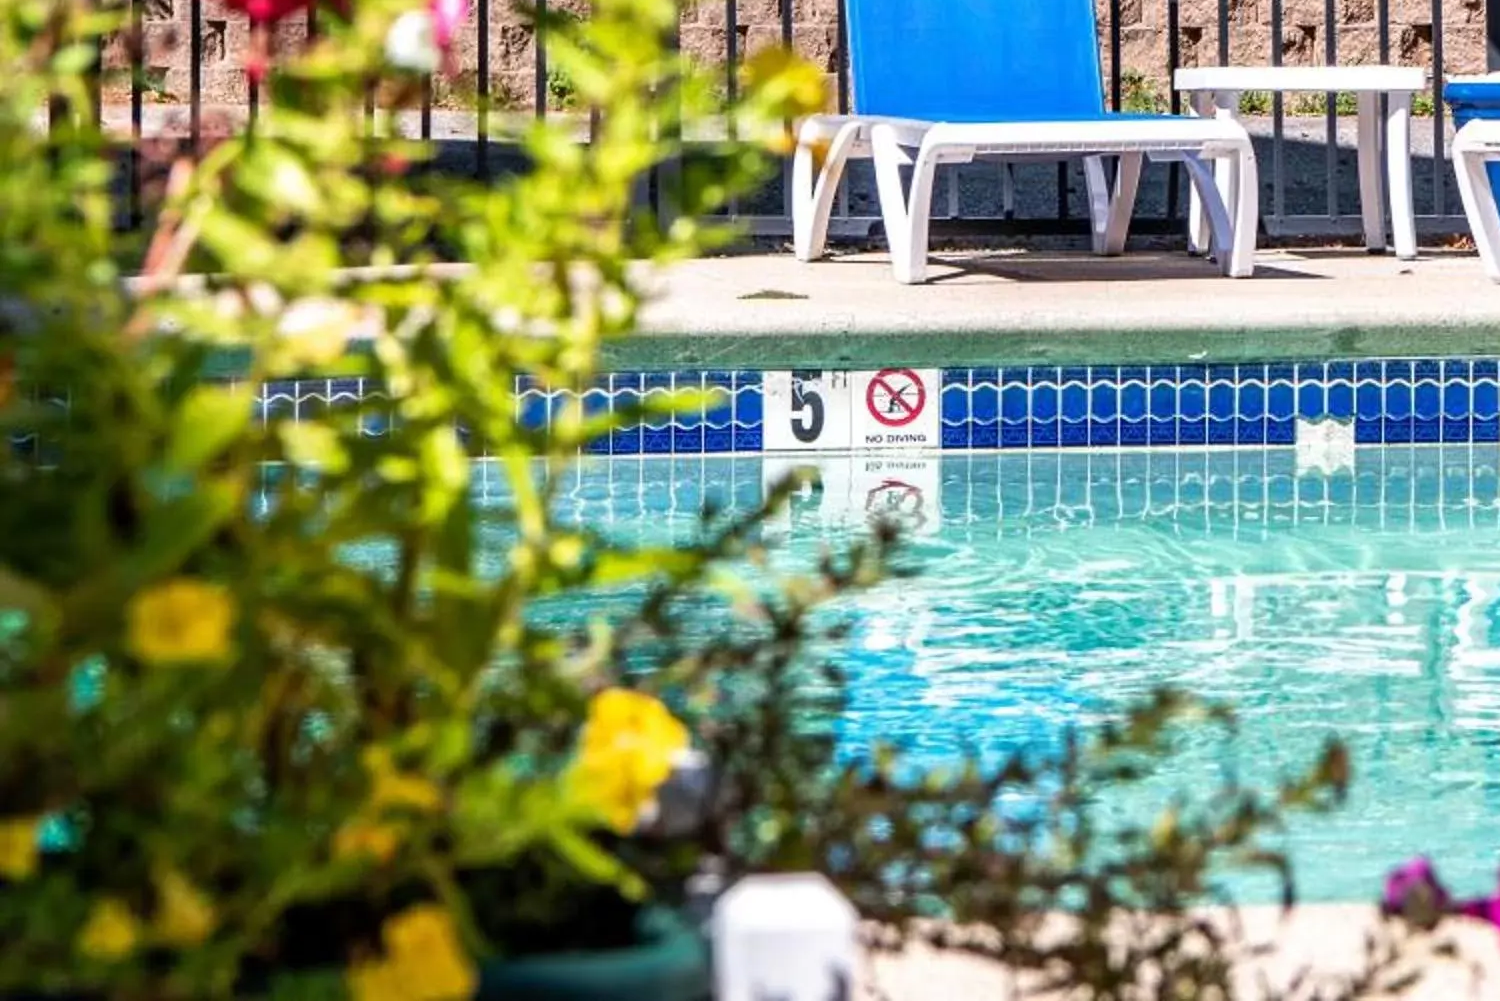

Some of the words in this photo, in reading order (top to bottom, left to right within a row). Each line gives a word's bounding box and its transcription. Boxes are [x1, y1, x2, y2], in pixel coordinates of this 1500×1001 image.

[791, 368, 824, 443] 5
[865, 435, 883, 444] NO
[886, 434, 927, 444] DIVING
